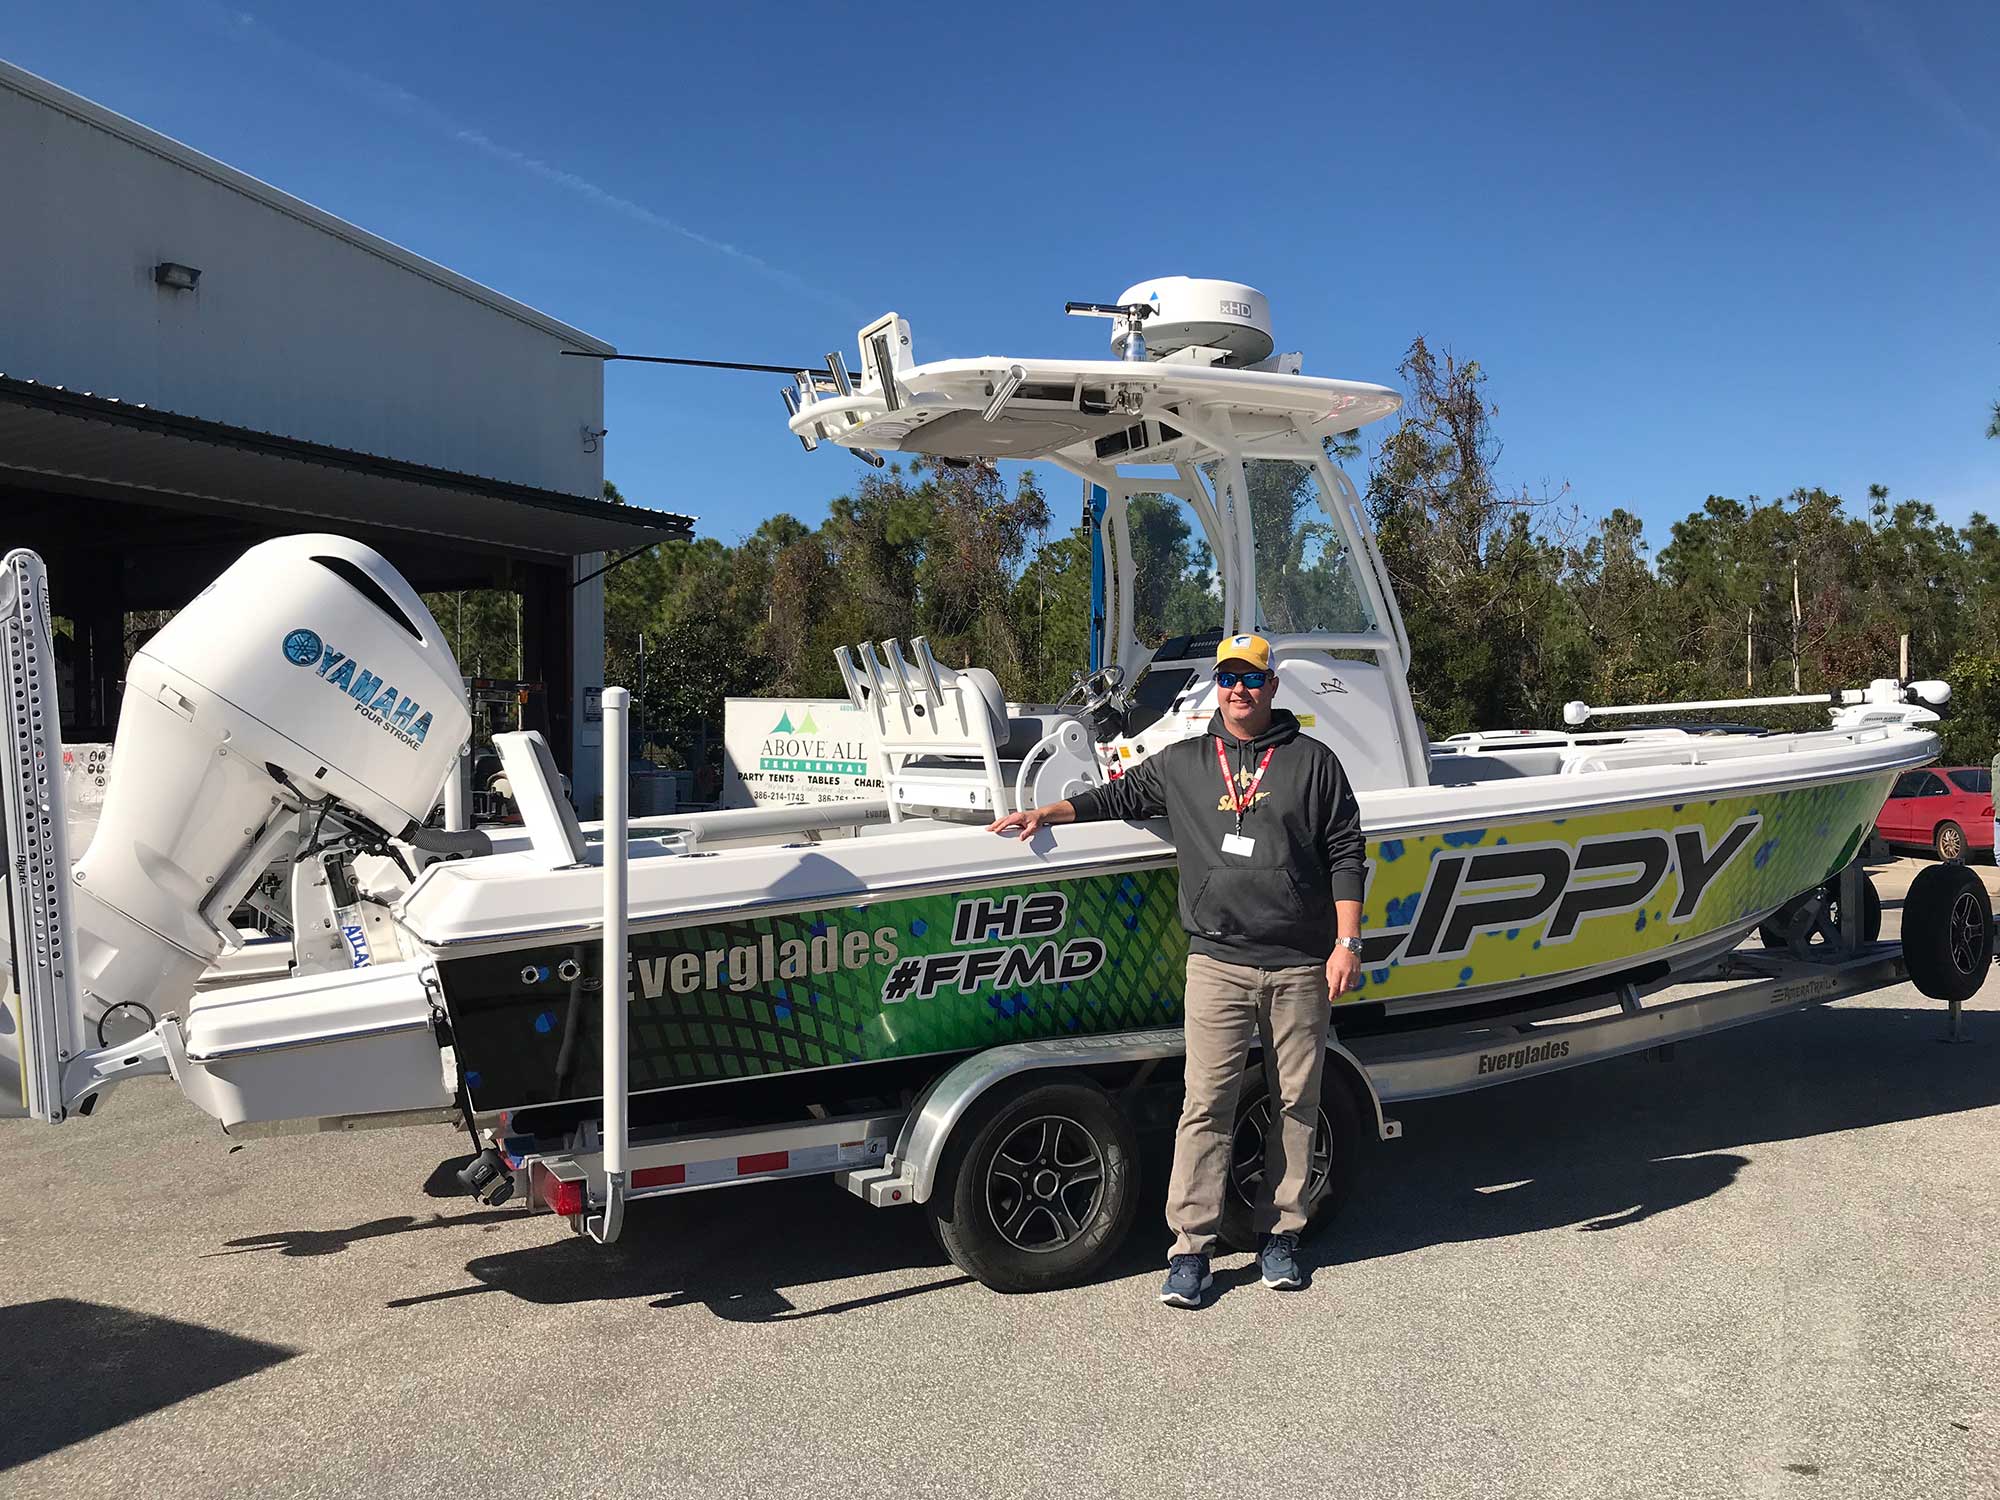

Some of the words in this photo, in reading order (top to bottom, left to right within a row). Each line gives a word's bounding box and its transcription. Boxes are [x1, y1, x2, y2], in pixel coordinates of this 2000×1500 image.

[1220, 302, 1251, 318] xHD
[316, 644, 434, 744] YAMAHA
[355, 703, 382, 726] FOUR
[383, 722, 421, 751] STROKE
[761, 739, 825, 758] ABOVE
[832, 741, 868, 760] ALL
[738, 772, 764, 781] PARTY
[769, 774, 794, 783] TENTS
[808, 775, 840, 785] TABLES
[754, 790, 805, 801] 386-214-1743
[952, 893, 1067, 944] IHB
[342, 925, 373, 968] ATLA
[882, 938, 1105, 1003] #FFMD
[1478, 1041, 1570, 1074] Everglades
